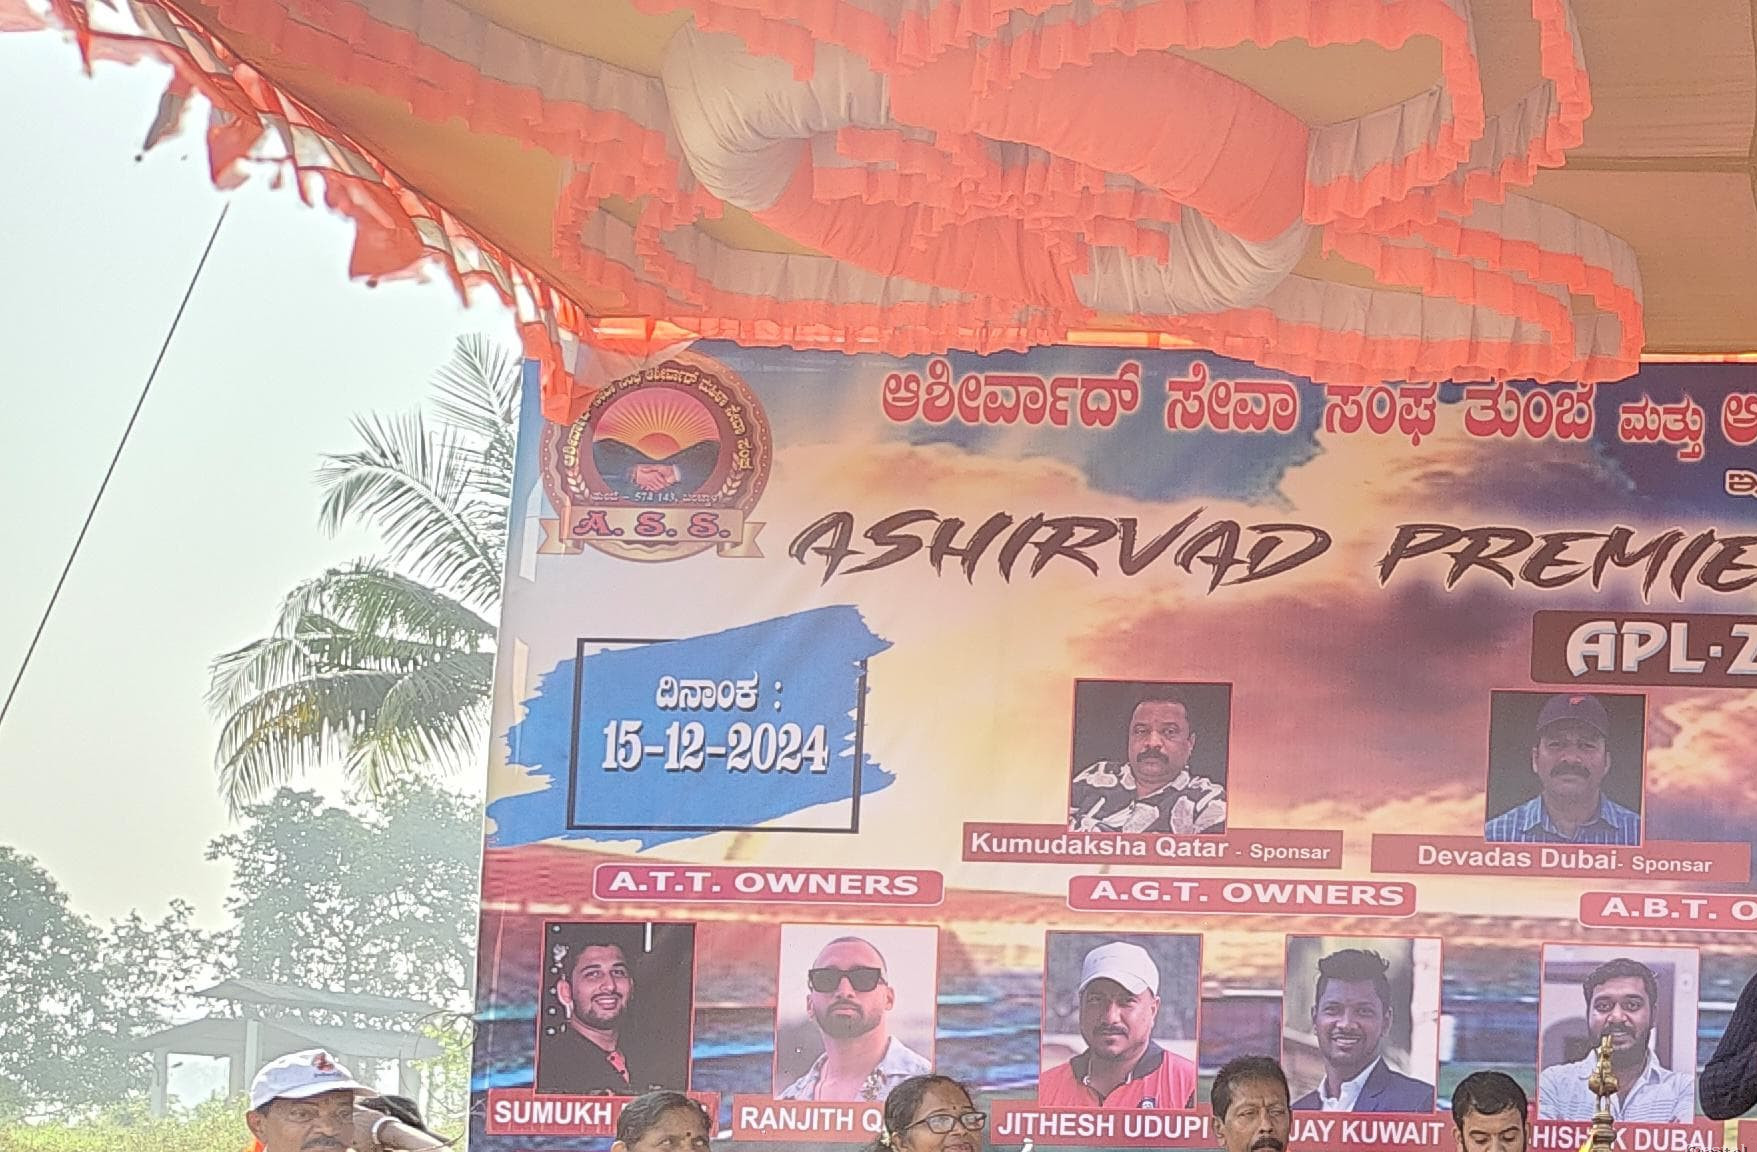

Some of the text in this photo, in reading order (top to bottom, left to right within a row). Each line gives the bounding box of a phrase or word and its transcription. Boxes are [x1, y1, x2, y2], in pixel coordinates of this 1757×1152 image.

[882, 360, 1140, 427] ಆಶೀರ್ವಾದ್
[1166, 364, 1297, 431] ಸೇವಾ
[1326, 384, 1437, 446] ಸಂಘ
[1620, 398, 1703, 457] ಮತ್ತು
[789, 506, 1332, 594] ASHIRVAD
[655, 671, 759, 710] ದಿನಾಂಕ
[602, 720, 829, 773] 15-12-2024
[970, 833, 1146, 858] Kumudaksha
[1155, 836, 1229, 859] Qatar
[1250, 843, 1331, 863] Sponsar
[1417, 845, 1531, 868] Devadas
[1632, 855, 1712, 874] Sponsar
[609, 871, 919, 896] A.T.T. OWNERS
[1089, 880, 1404, 906] A.G.T. OWNERS
[1601, 897, 1717, 920] A.B.T.
[494, 1100, 612, 1125] SUMUKH
[740, 1106, 854, 1131] RANJITH
[997, 1112, 1209, 1139] JITHESH UDUPI
[1289, 1119, 1445, 1146] JAY KUWAIT
[1634, 1129, 1713, 1152] DUBAI
